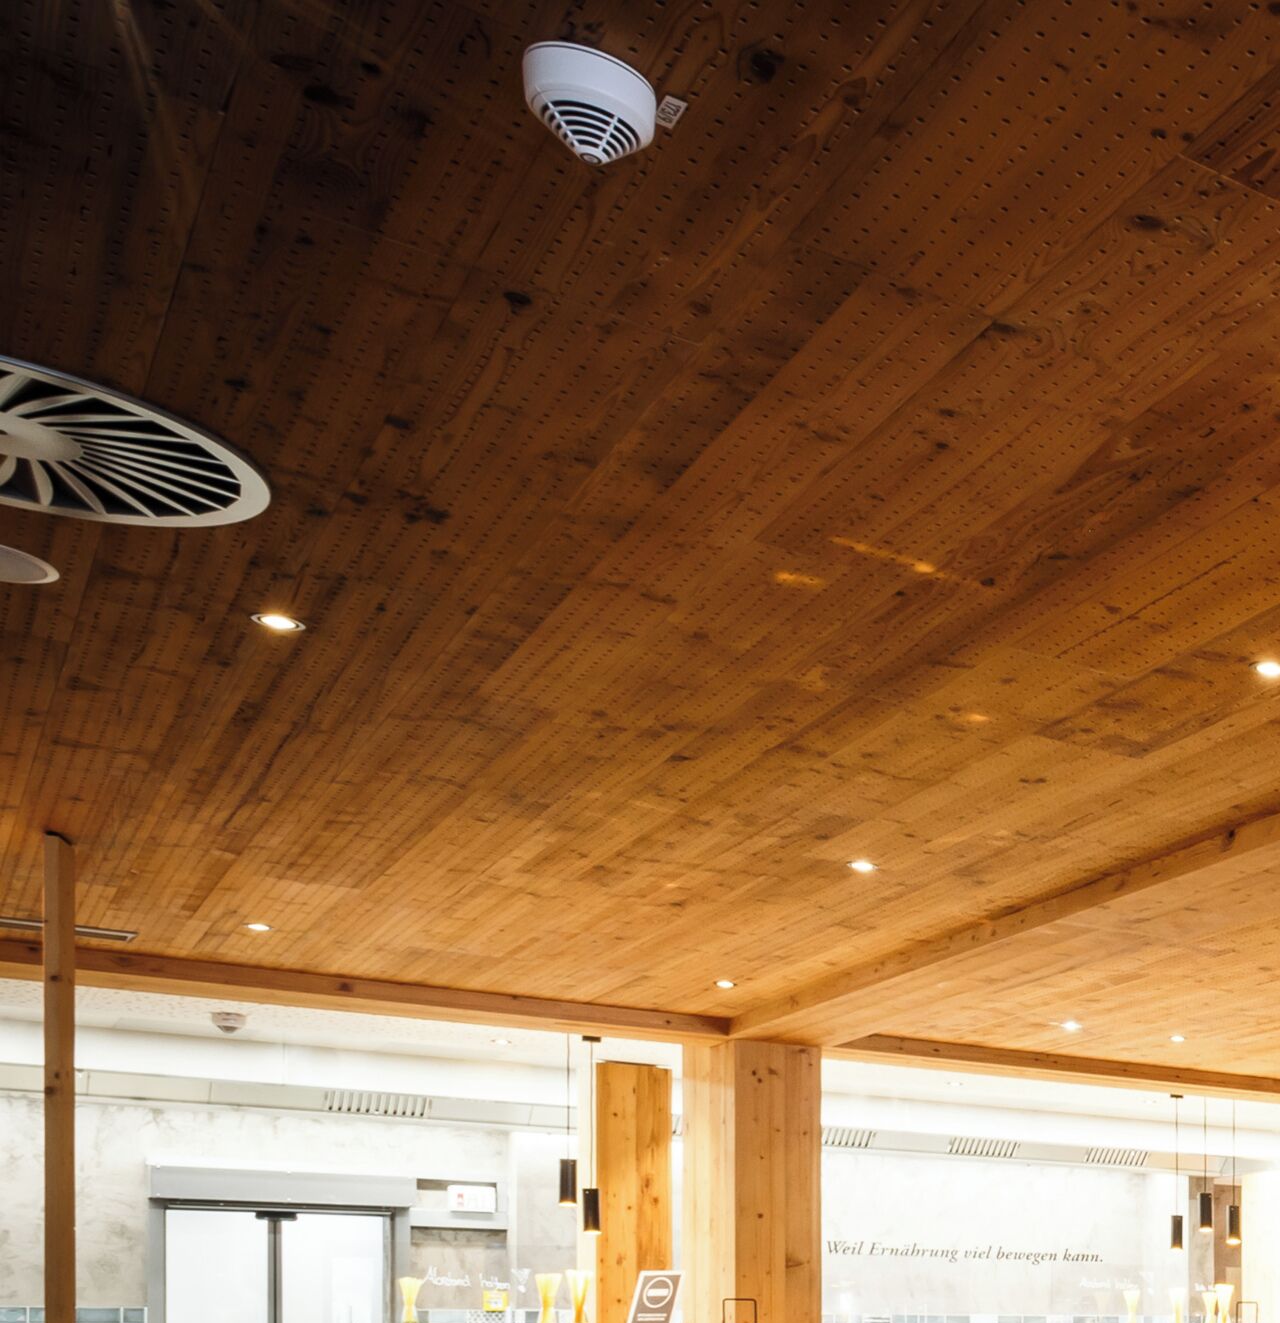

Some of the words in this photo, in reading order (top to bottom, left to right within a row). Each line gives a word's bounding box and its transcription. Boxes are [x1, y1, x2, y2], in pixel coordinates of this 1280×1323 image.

[827, 1240, 865, 1255] Weil
[869, 1242, 958, 1263] Ernährung
[964, 1246, 992, 1259] viel
[996, 1246, 1057, 1265] bewegen
[1062, 1248, 1103, 1262] kann.
